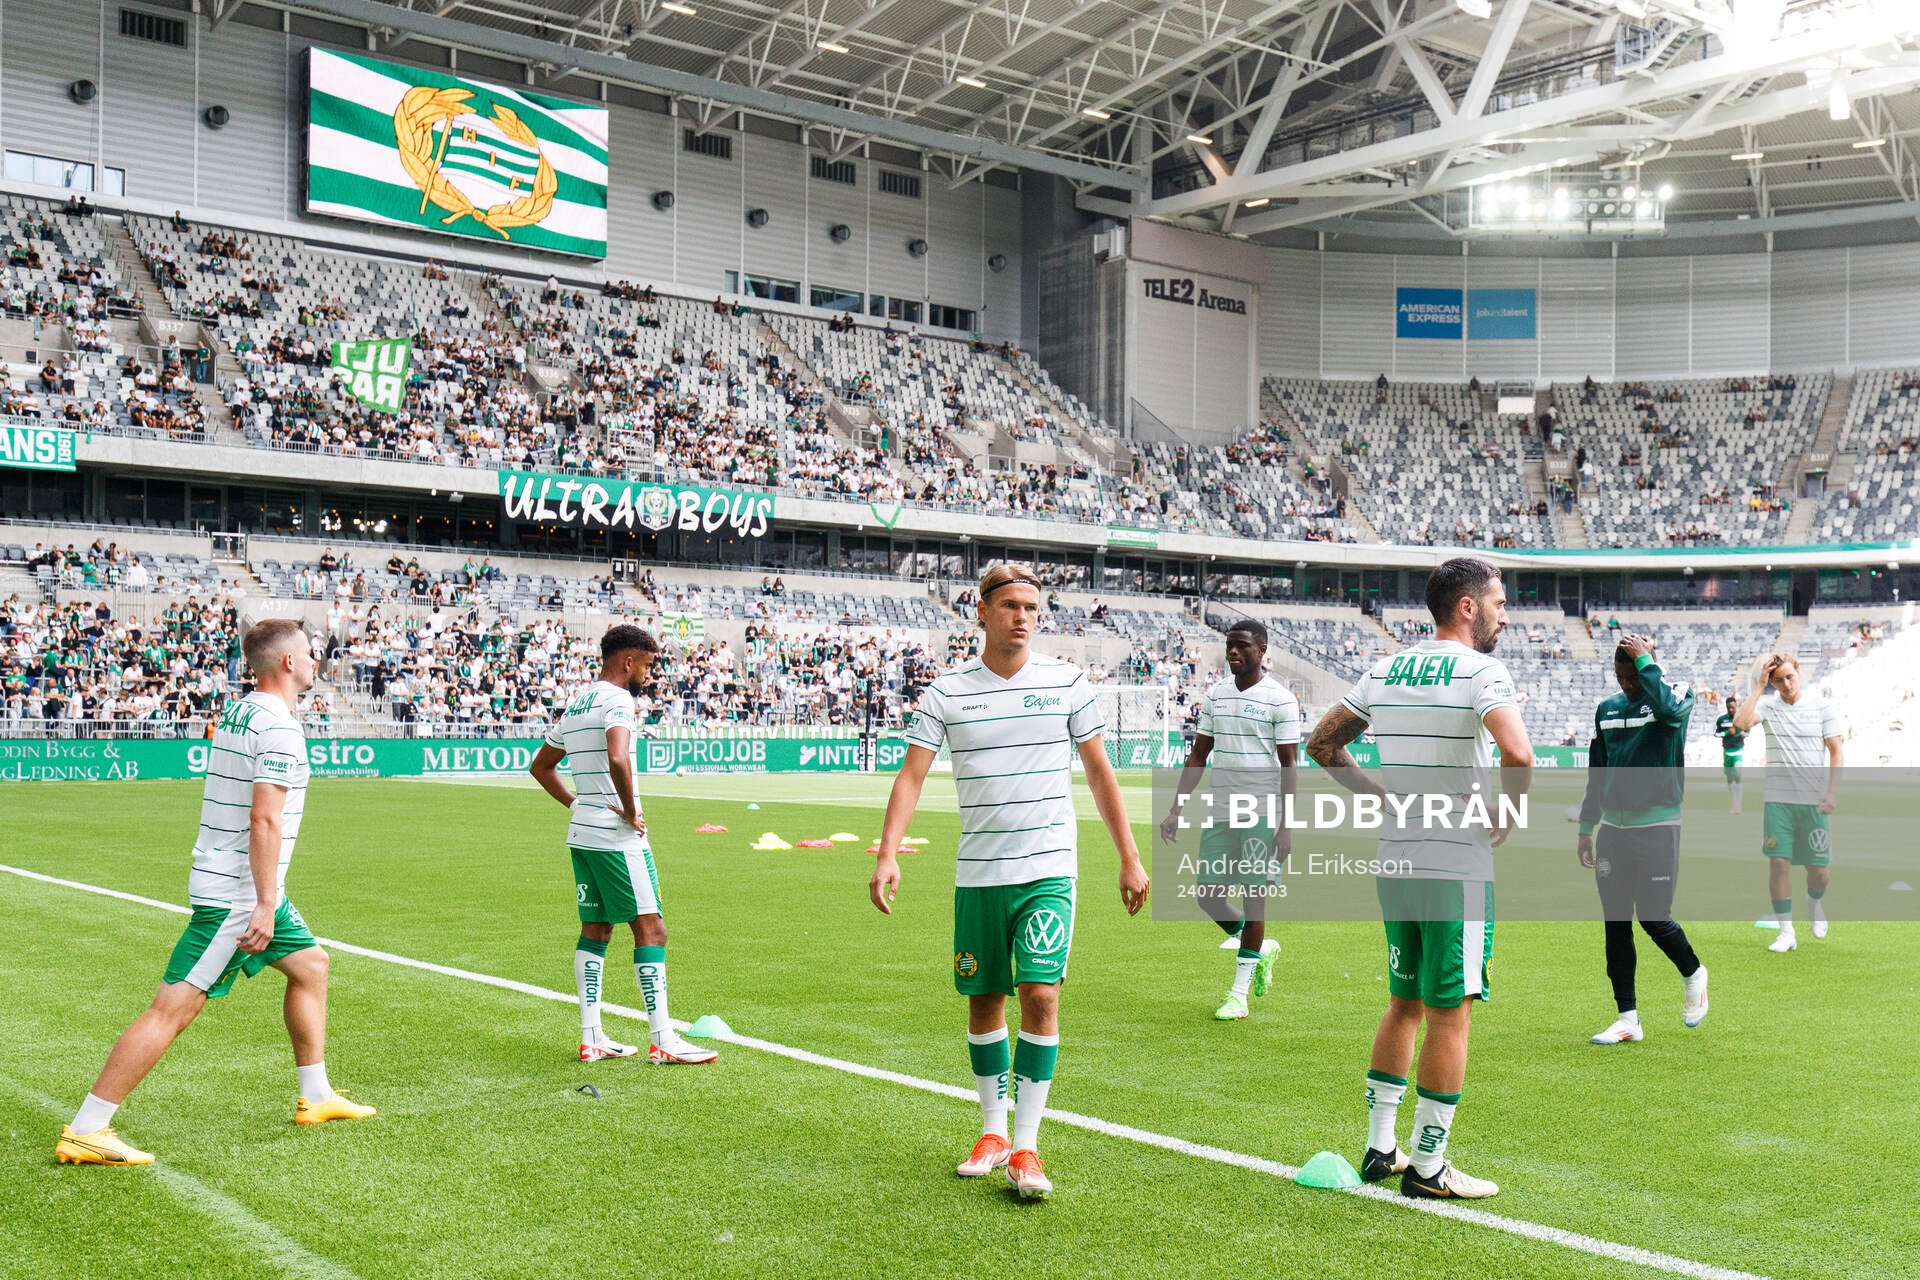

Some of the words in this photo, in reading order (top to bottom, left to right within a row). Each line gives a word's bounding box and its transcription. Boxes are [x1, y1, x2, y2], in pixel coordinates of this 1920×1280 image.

[1144, 279, 1194, 305] TELE2
[1197, 288, 1246, 314] Arena
[1400, 304, 1460, 313] AMERICAN
[1408, 314, 1461, 323] EXPRESS
[57, 431, 72, 463] 1981
[504, 475, 634, 528] ULTRA
[677, 490, 772, 538] BOYS
[1384, 655, 1460, 687] BAJEN
[1023, 694, 1062, 711] Bajen
[103, 741, 121, 758] &
[309, 741, 375, 764] stro
[678, 741, 766, 762] PROJOB
[106, 761, 139, 779] AB
